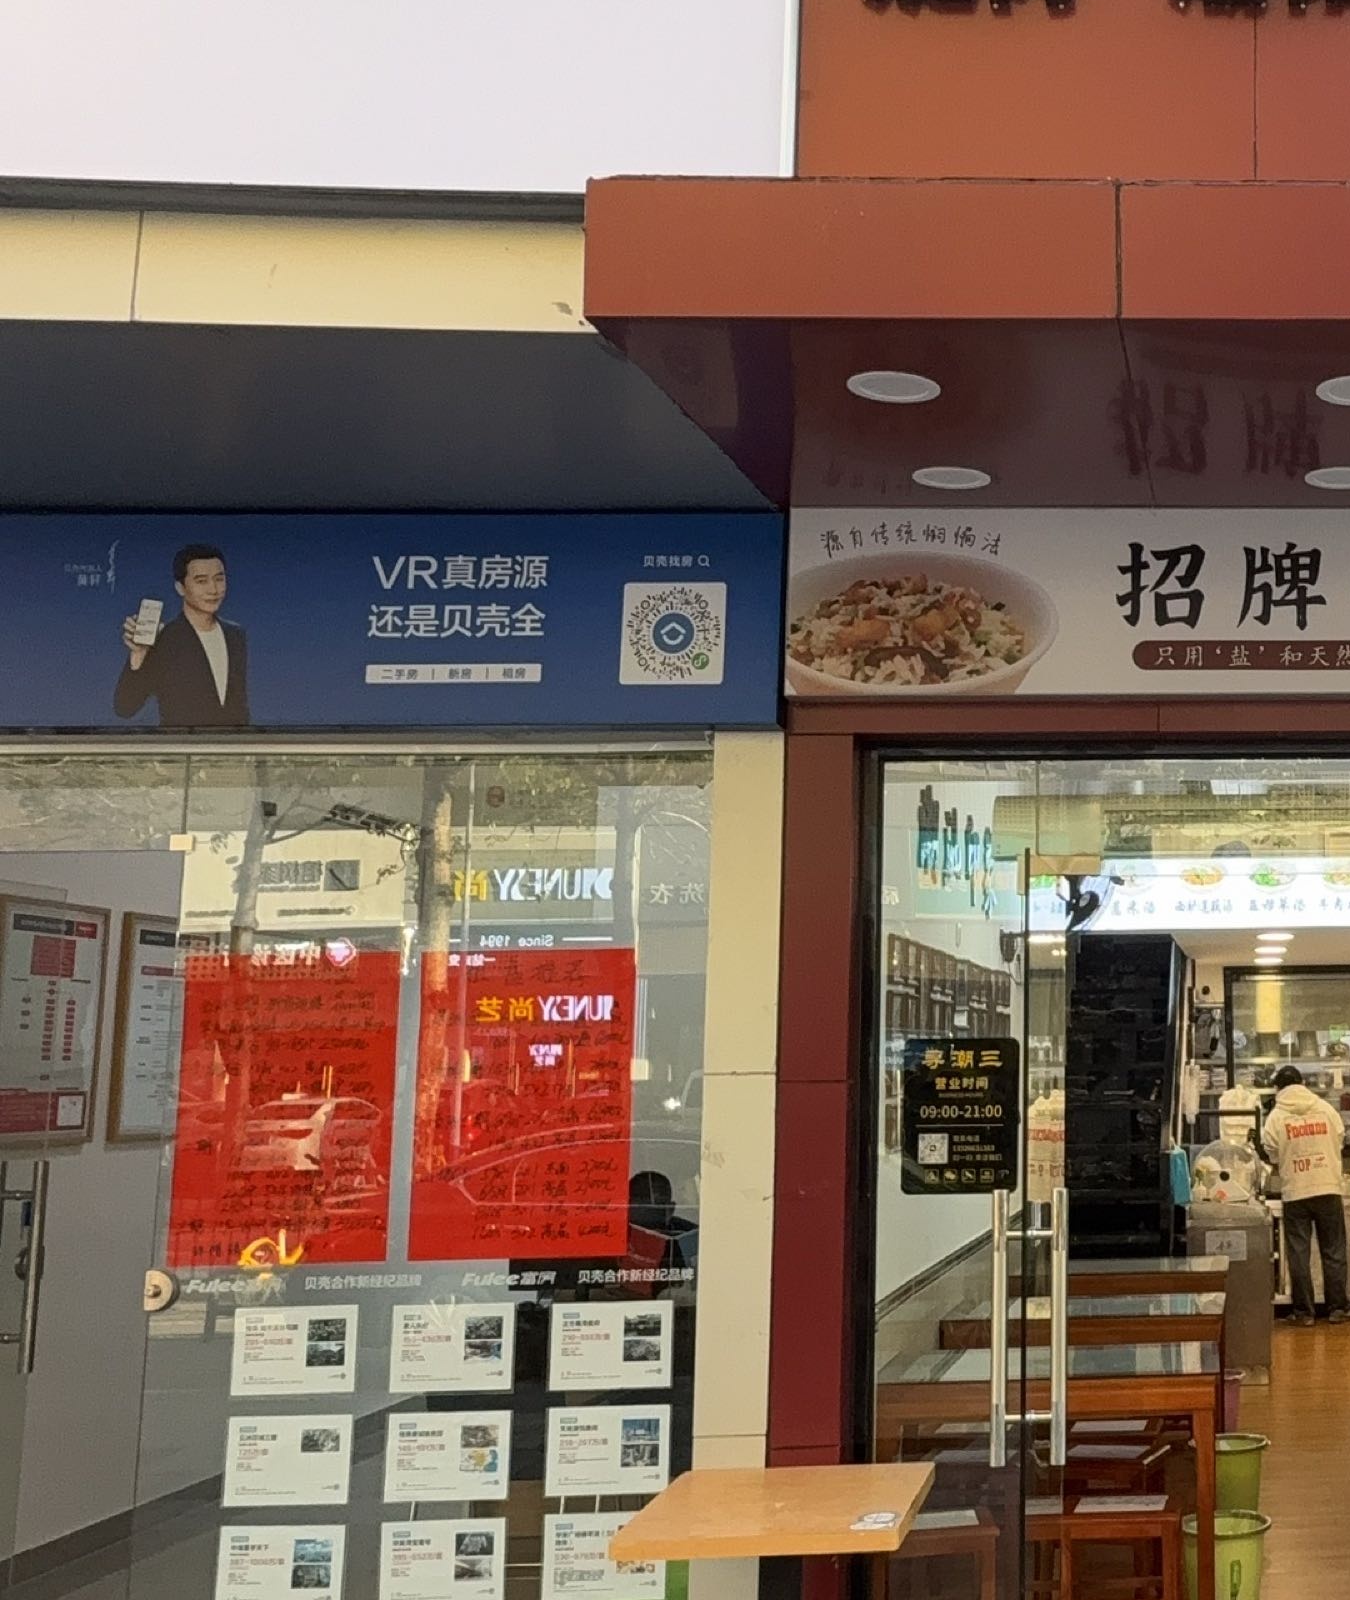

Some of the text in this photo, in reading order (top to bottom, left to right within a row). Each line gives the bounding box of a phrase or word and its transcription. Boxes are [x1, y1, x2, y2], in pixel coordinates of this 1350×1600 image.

[372, 554, 550, 590] VR真房源
[367, 603, 546, 639] 还是贝壳全
[922, 1047, 1003, 1070] 寻潮三
[919, 1104, 1003, 1119] 09:00-21:00
[304, 1273, 422, 1291] 贝壳合作新经纪品牌
[577, 1268, 695, 1285] 贝壳合作新经纪品牌
